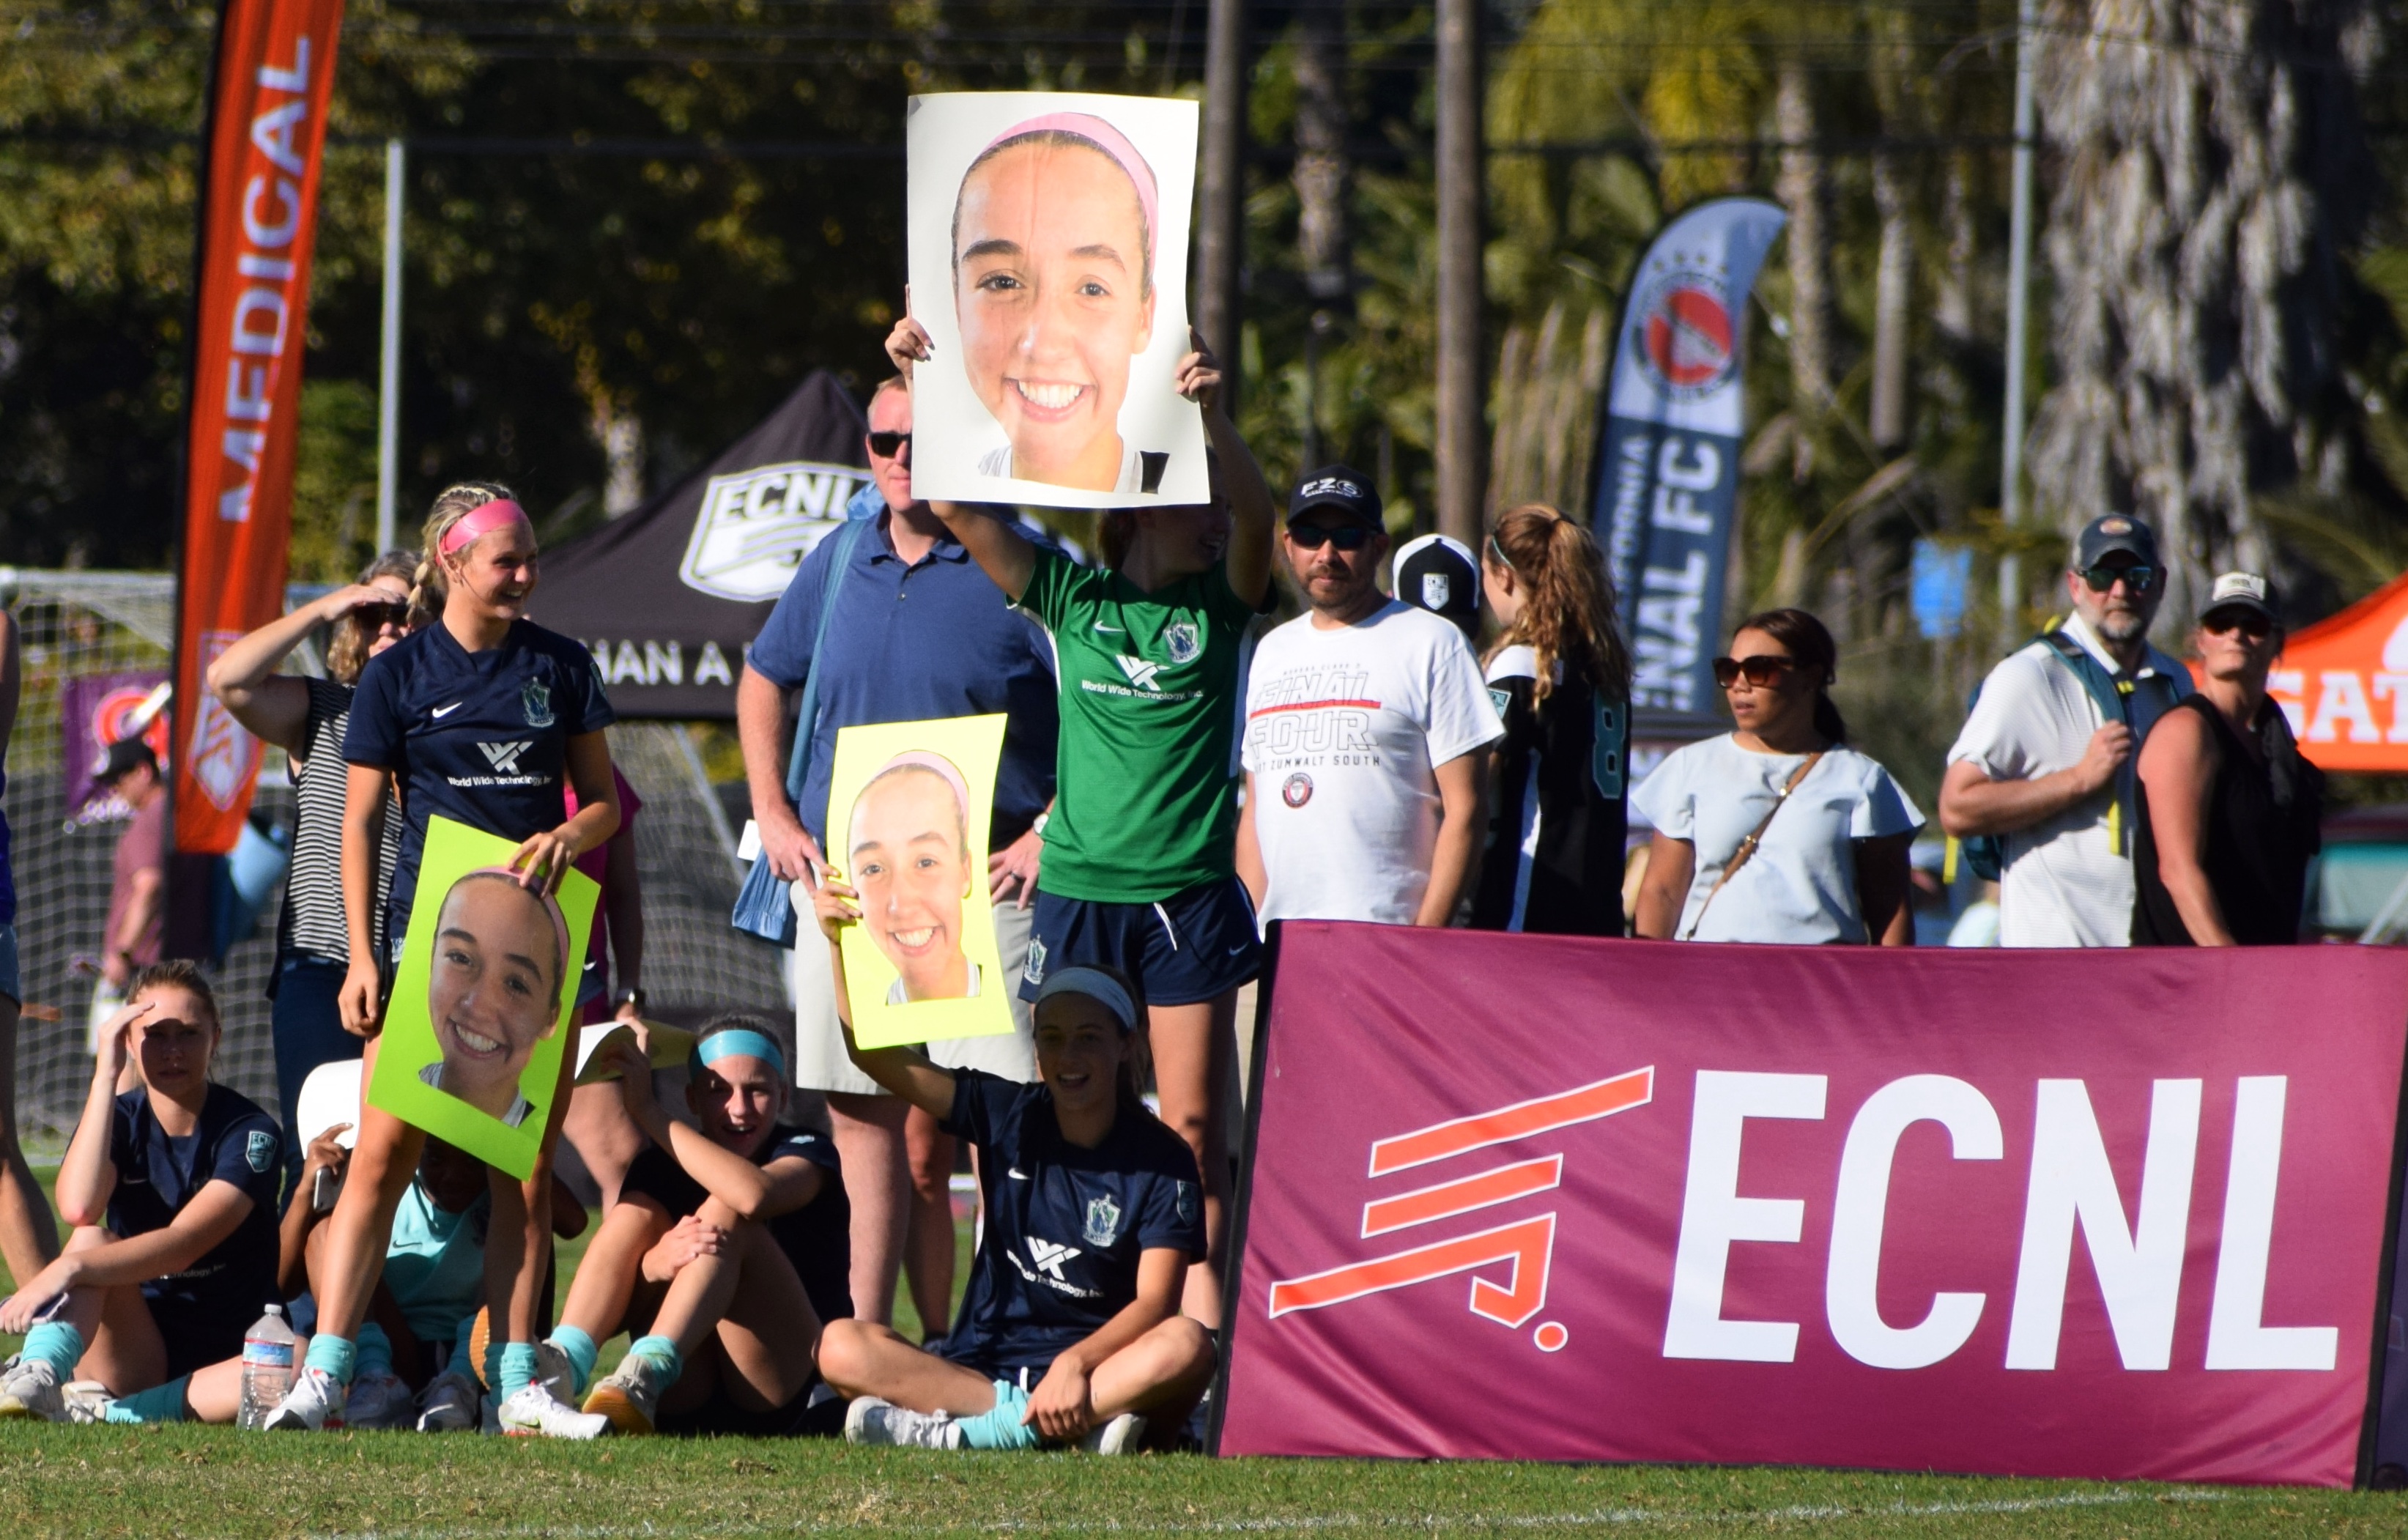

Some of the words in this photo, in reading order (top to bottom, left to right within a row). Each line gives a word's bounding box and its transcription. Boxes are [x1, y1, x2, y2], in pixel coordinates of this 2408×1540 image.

[218, 34, 311, 525] MEDICAL
[713, 472, 851, 525] ECNL
[1651, 437, 1722, 536] FC
[694, 640, 733, 686] A
[1081, 679, 1106, 693] World
[1108, 684, 1132, 696] Wide
[1253, 670, 1374, 711] FINAL
[1248, 710, 1379, 759] FOUR
[1592, 686, 1627, 800] 8
[447, 777, 473, 788] World
[472, 776, 495, 786] Wide
[1270, 755, 1325, 770] ZUMWALT
[1333, 755, 1380, 767] SOUTH
[1662, 1067, 2339, 1371] ECNL
